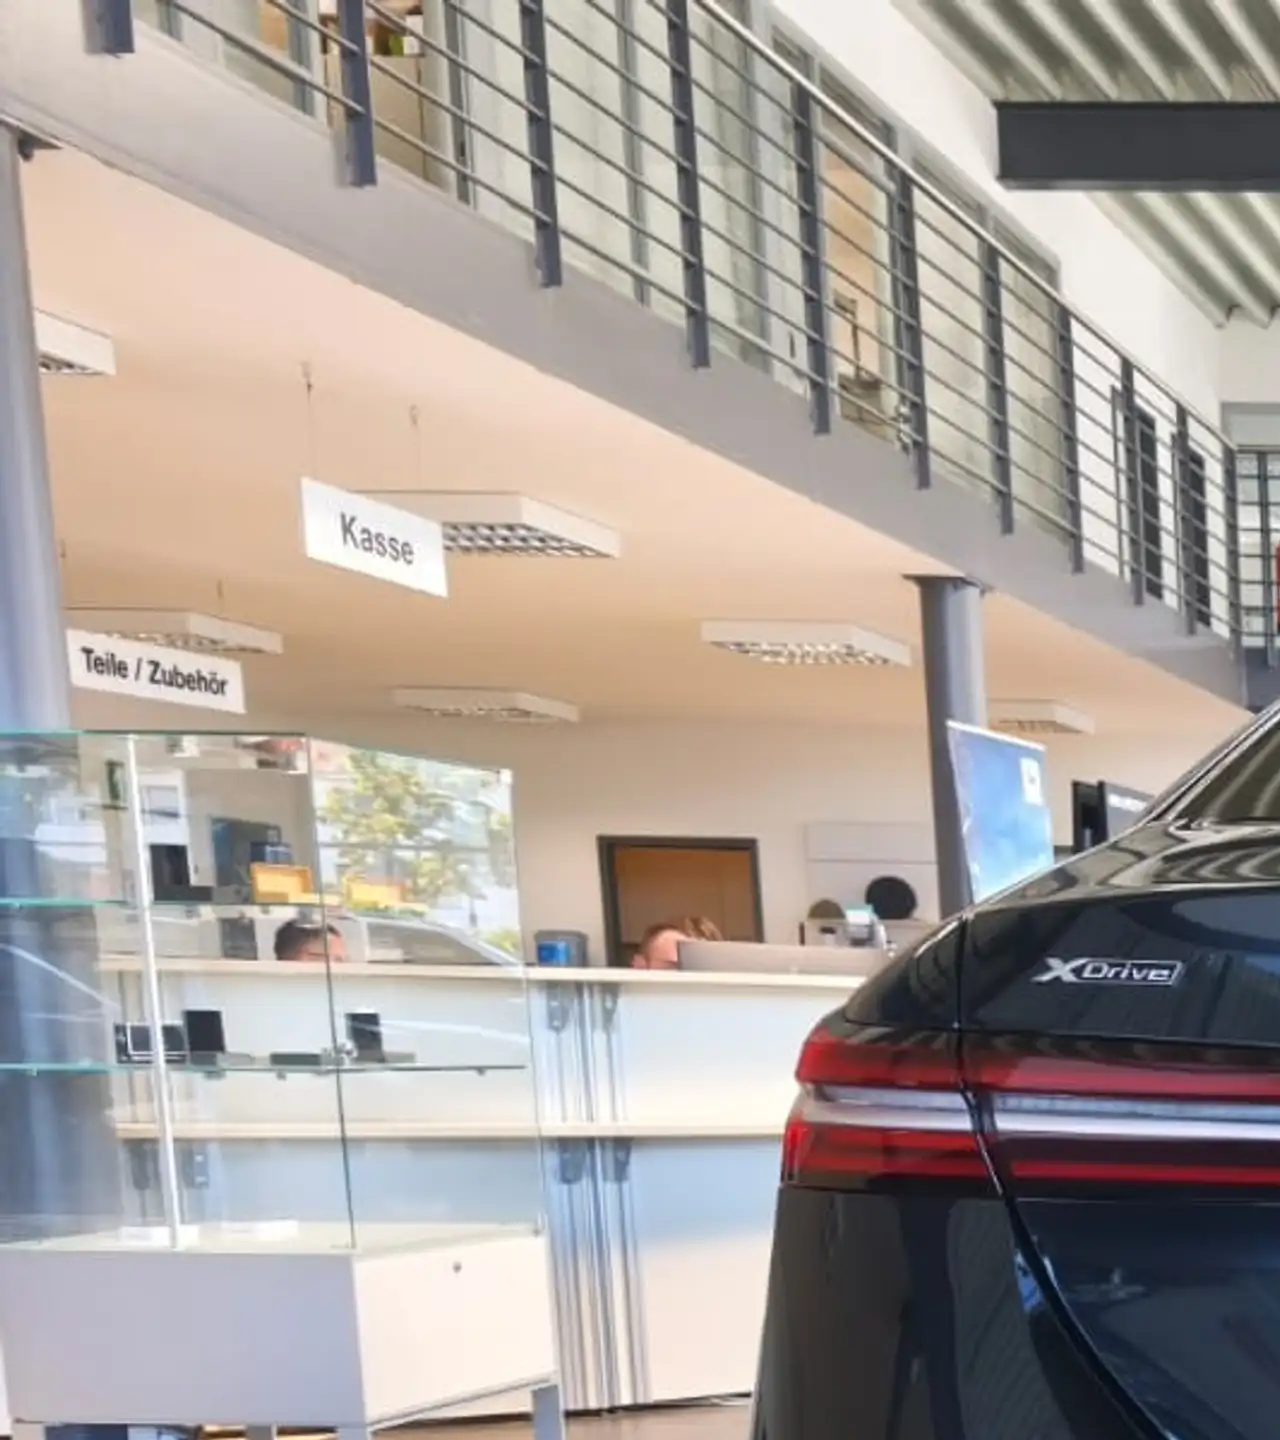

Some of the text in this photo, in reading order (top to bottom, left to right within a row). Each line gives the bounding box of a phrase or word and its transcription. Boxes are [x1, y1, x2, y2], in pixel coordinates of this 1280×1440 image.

[340, 511, 415, 566] Kasse
[80, 646, 229, 696] Teile / Zubehör
